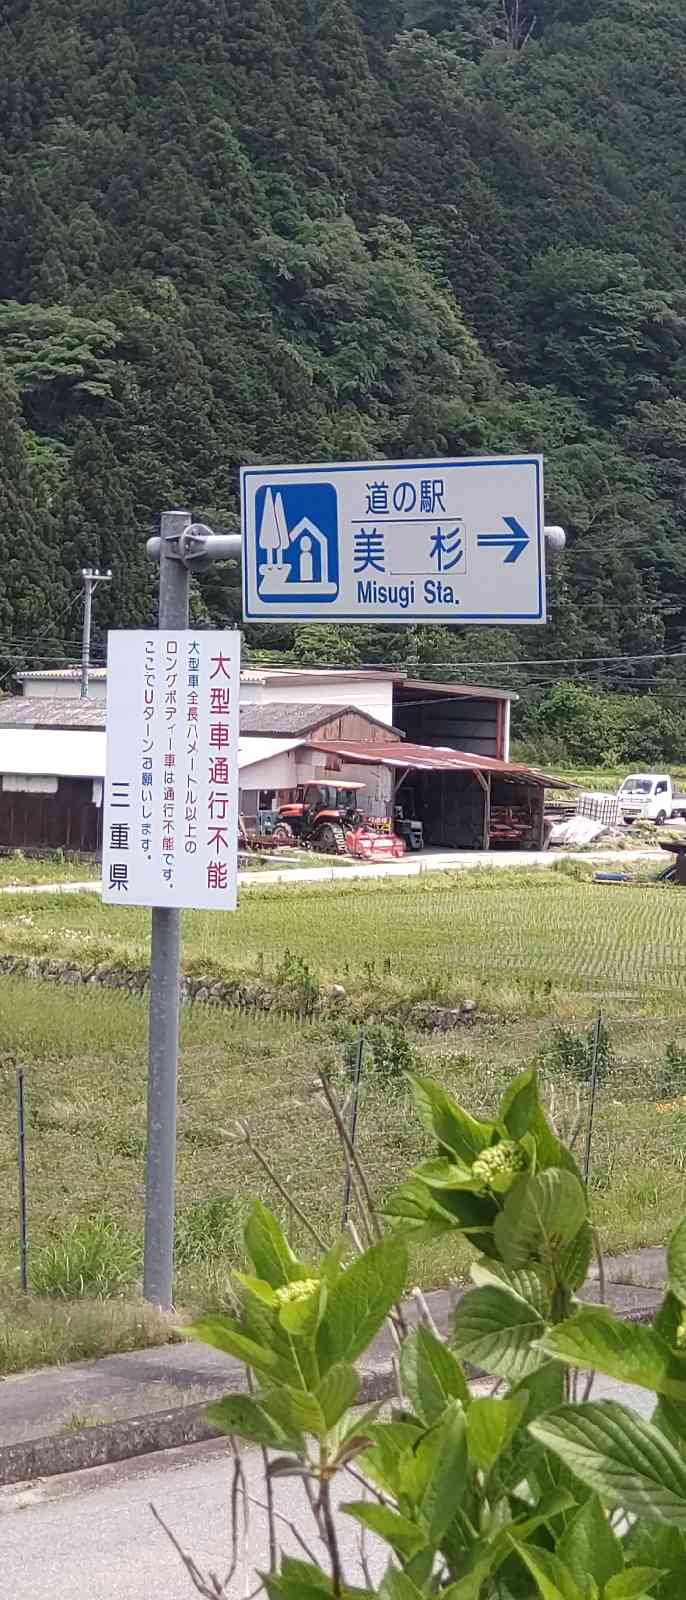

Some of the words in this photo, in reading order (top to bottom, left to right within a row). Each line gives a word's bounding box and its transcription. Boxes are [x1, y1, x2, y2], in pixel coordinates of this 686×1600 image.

[366, 479, 446, 514] 道の駅
[357, 581, 415, 608] Misugi
[423, 580, 460, 605] Sta.
[141, 640, 156, 860] ここでUターンお願いします。
[162, 640, 178, 888] ロングボディー車は通行不能です。
[206, 649, 231, 889] 大型車通行不能
[108, 782, 131, 891] 三重県
